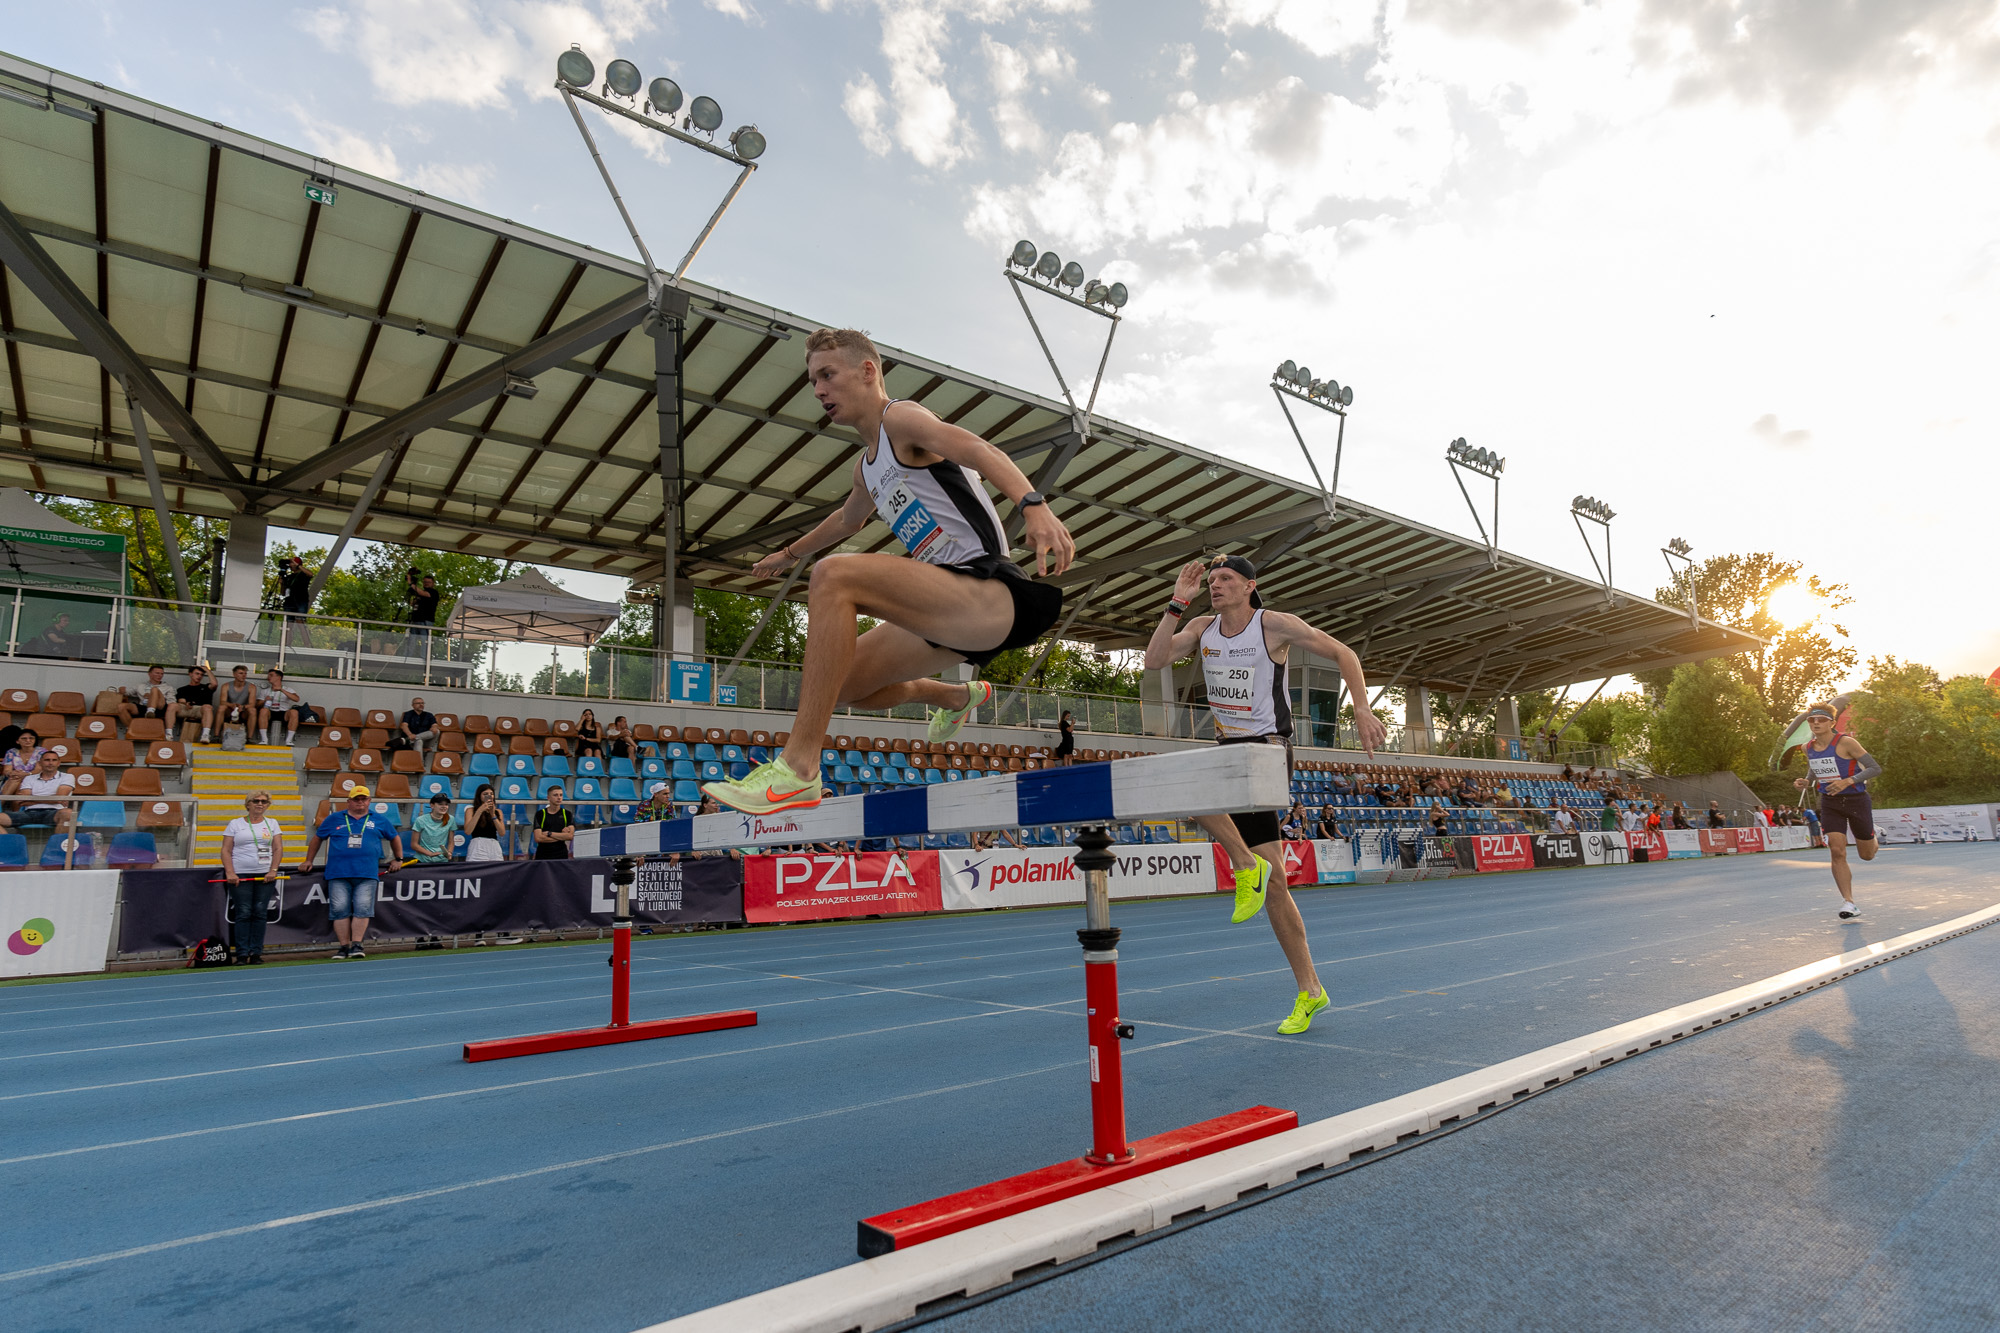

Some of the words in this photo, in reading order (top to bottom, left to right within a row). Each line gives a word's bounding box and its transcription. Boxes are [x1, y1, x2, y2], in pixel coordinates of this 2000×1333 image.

[888, 489, 907, 514] 245
[0, 528, 38, 538] DZTWA
[40, 534, 105, 546] LUBELSKIEGO
[678, 664, 703, 672] SEKTOR
[1228, 670, 1249, 680] 250
[682, 672, 700, 698] F
[720, 688, 735, 696] WC
[1209, 685, 1248, 700] JANDUŁA
[1512, 744, 1519, 758] H
[1630, 832, 1660, 850] PZLA
[1738, 828, 1760, 842] PZLA
[1480, 836, 1524, 856] PZLA
[1536, 834, 1548, 847] 4F
[1546, 840, 1577, 858] FUEL
[638, 862, 682, 872] AKADEMICKIE
[1148, 855, 1202, 876] SPORT
[639, 872, 682, 882] CENTRUM
[776, 854, 916, 894] PZLA
[990, 856, 1076, 892] polanik
[377, 878, 482, 902] LUBLIN
[638, 882, 682, 892] SZKOLENIA
[638, 891, 682, 902] SPORTOWEGO
[776, 900, 809, 908] POLSKI
[810, 896, 850, 906] ZWIĄZEK
[851, 894, 884, 902] LEKKIEJ
[886, 892, 918, 900] ATLETYKI
[638, 902, 645, 911] W
[648, 901, 682, 911] LUBLINIE
[203, 952, 227, 962] obry
